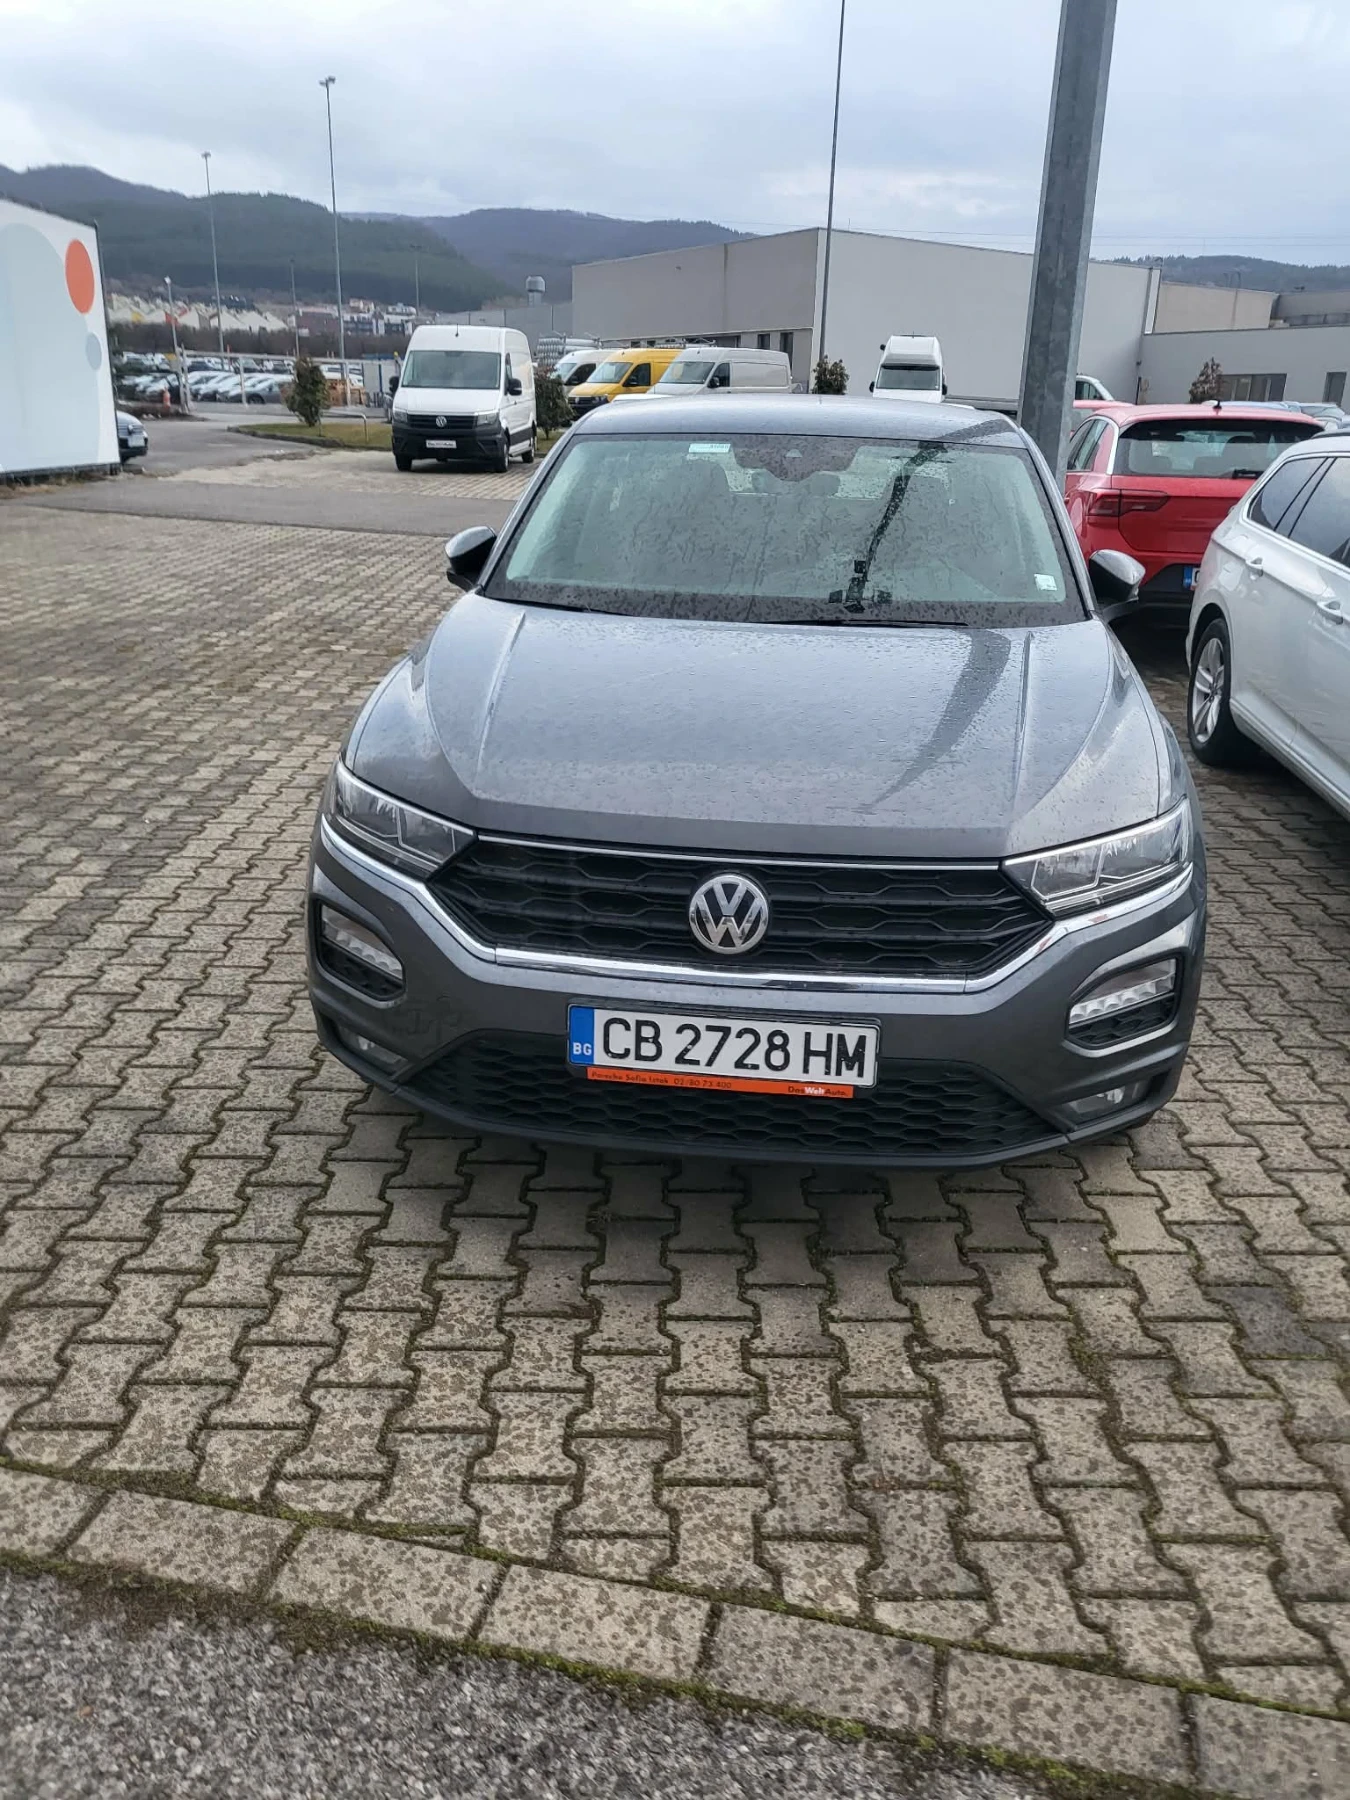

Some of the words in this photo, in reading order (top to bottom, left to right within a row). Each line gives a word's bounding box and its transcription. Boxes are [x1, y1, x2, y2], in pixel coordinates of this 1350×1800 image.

[573, 1043, 592, 1056] BG
[603, 1017, 663, 1063] CB
[674, 1023, 791, 1072] 2728
[802, 1031, 867, 1078] HM
[625, 1074, 647, 1083] Sofia
